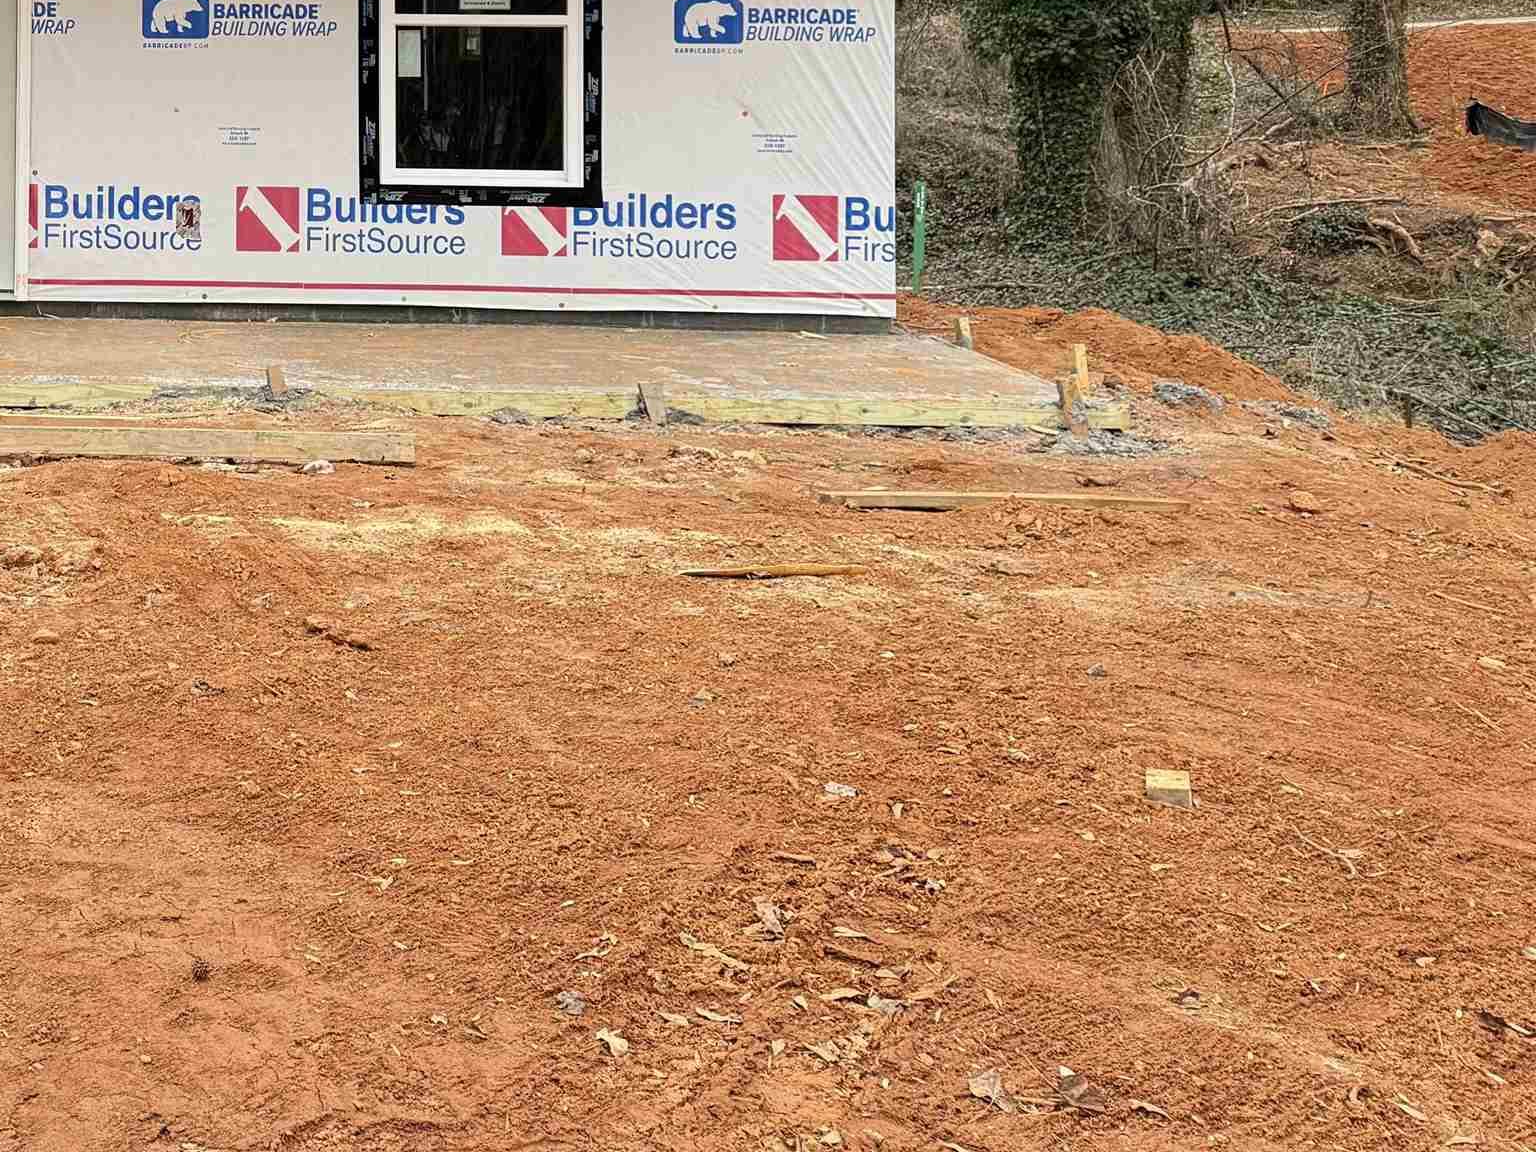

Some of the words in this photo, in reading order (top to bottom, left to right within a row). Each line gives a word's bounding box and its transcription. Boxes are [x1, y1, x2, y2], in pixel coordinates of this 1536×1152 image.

[214, 3, 319, 20] BARRICADE
[748, 8, 857, 25] BARRICADE
[32, 18, 76, 34] WRAP
[211, 20, 288, 37] BUILDING
[292, 21, 337, 37] WRAP
[746, 25, 824, 42] BUILDING
[829, 26, 876, 43] WRAP
[307, 227, 466, 255] FirstSource
[573, 232, 737, 260] FirstSource
